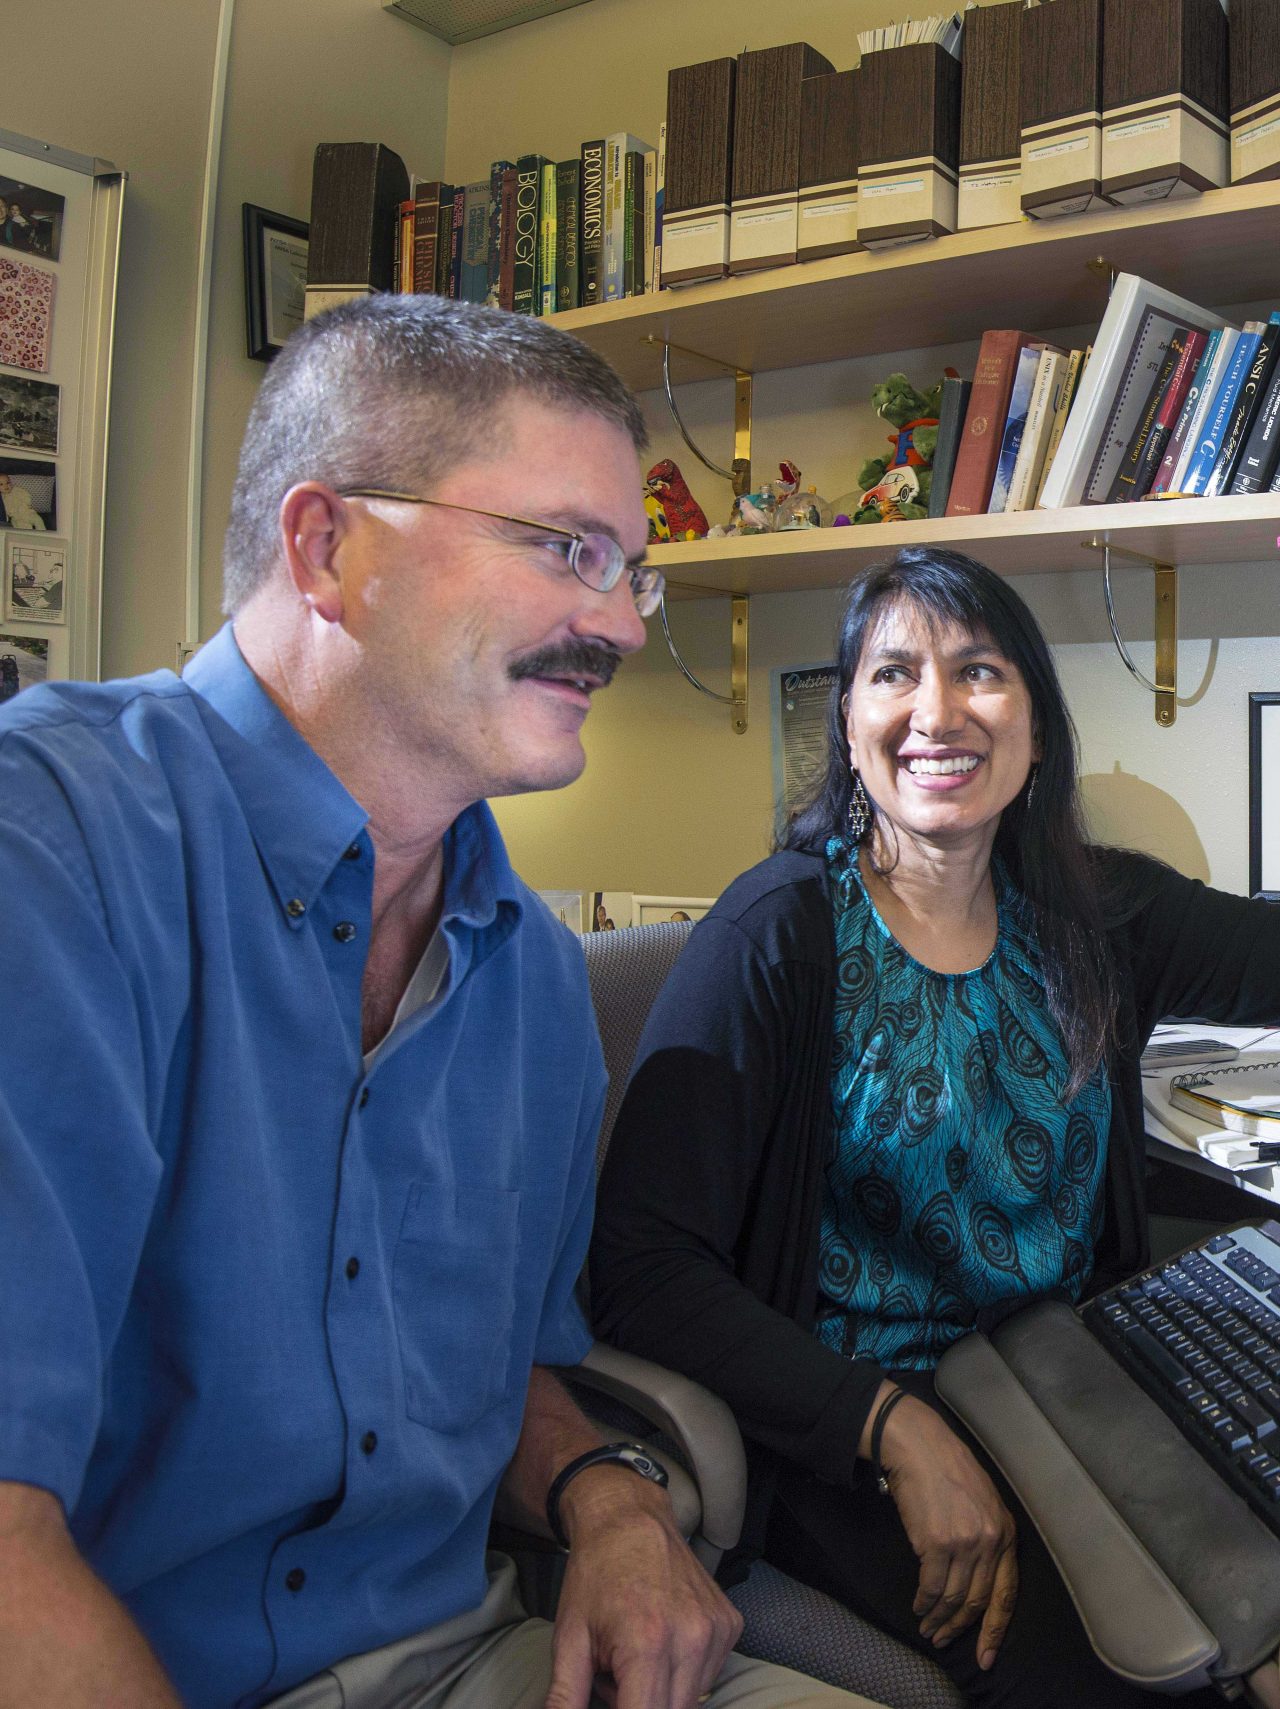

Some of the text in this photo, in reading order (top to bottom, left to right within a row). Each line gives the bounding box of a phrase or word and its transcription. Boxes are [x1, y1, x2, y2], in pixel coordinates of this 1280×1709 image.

[515, 171, 537, 267] BIOLOGY
[584, 147, 602, 239] ECONOMICS
[1044, 357, 1053, 374] UNIX
[1174, 343, 1192, 377] Essential
[1245, 342, 1270, 395] ANSI C
[1174, 386, 1199, 442] C++ Primer
[1200, 344, 1247, 458] TEACH YOURSELF C
[1262, 393, 1276, 422] Mechanics
[1131, 396, 1161, 464] Standard Library
[1147, 432, 1160, 461] Lippman
[1262, 416, 1275, 441] LIQUIDS
